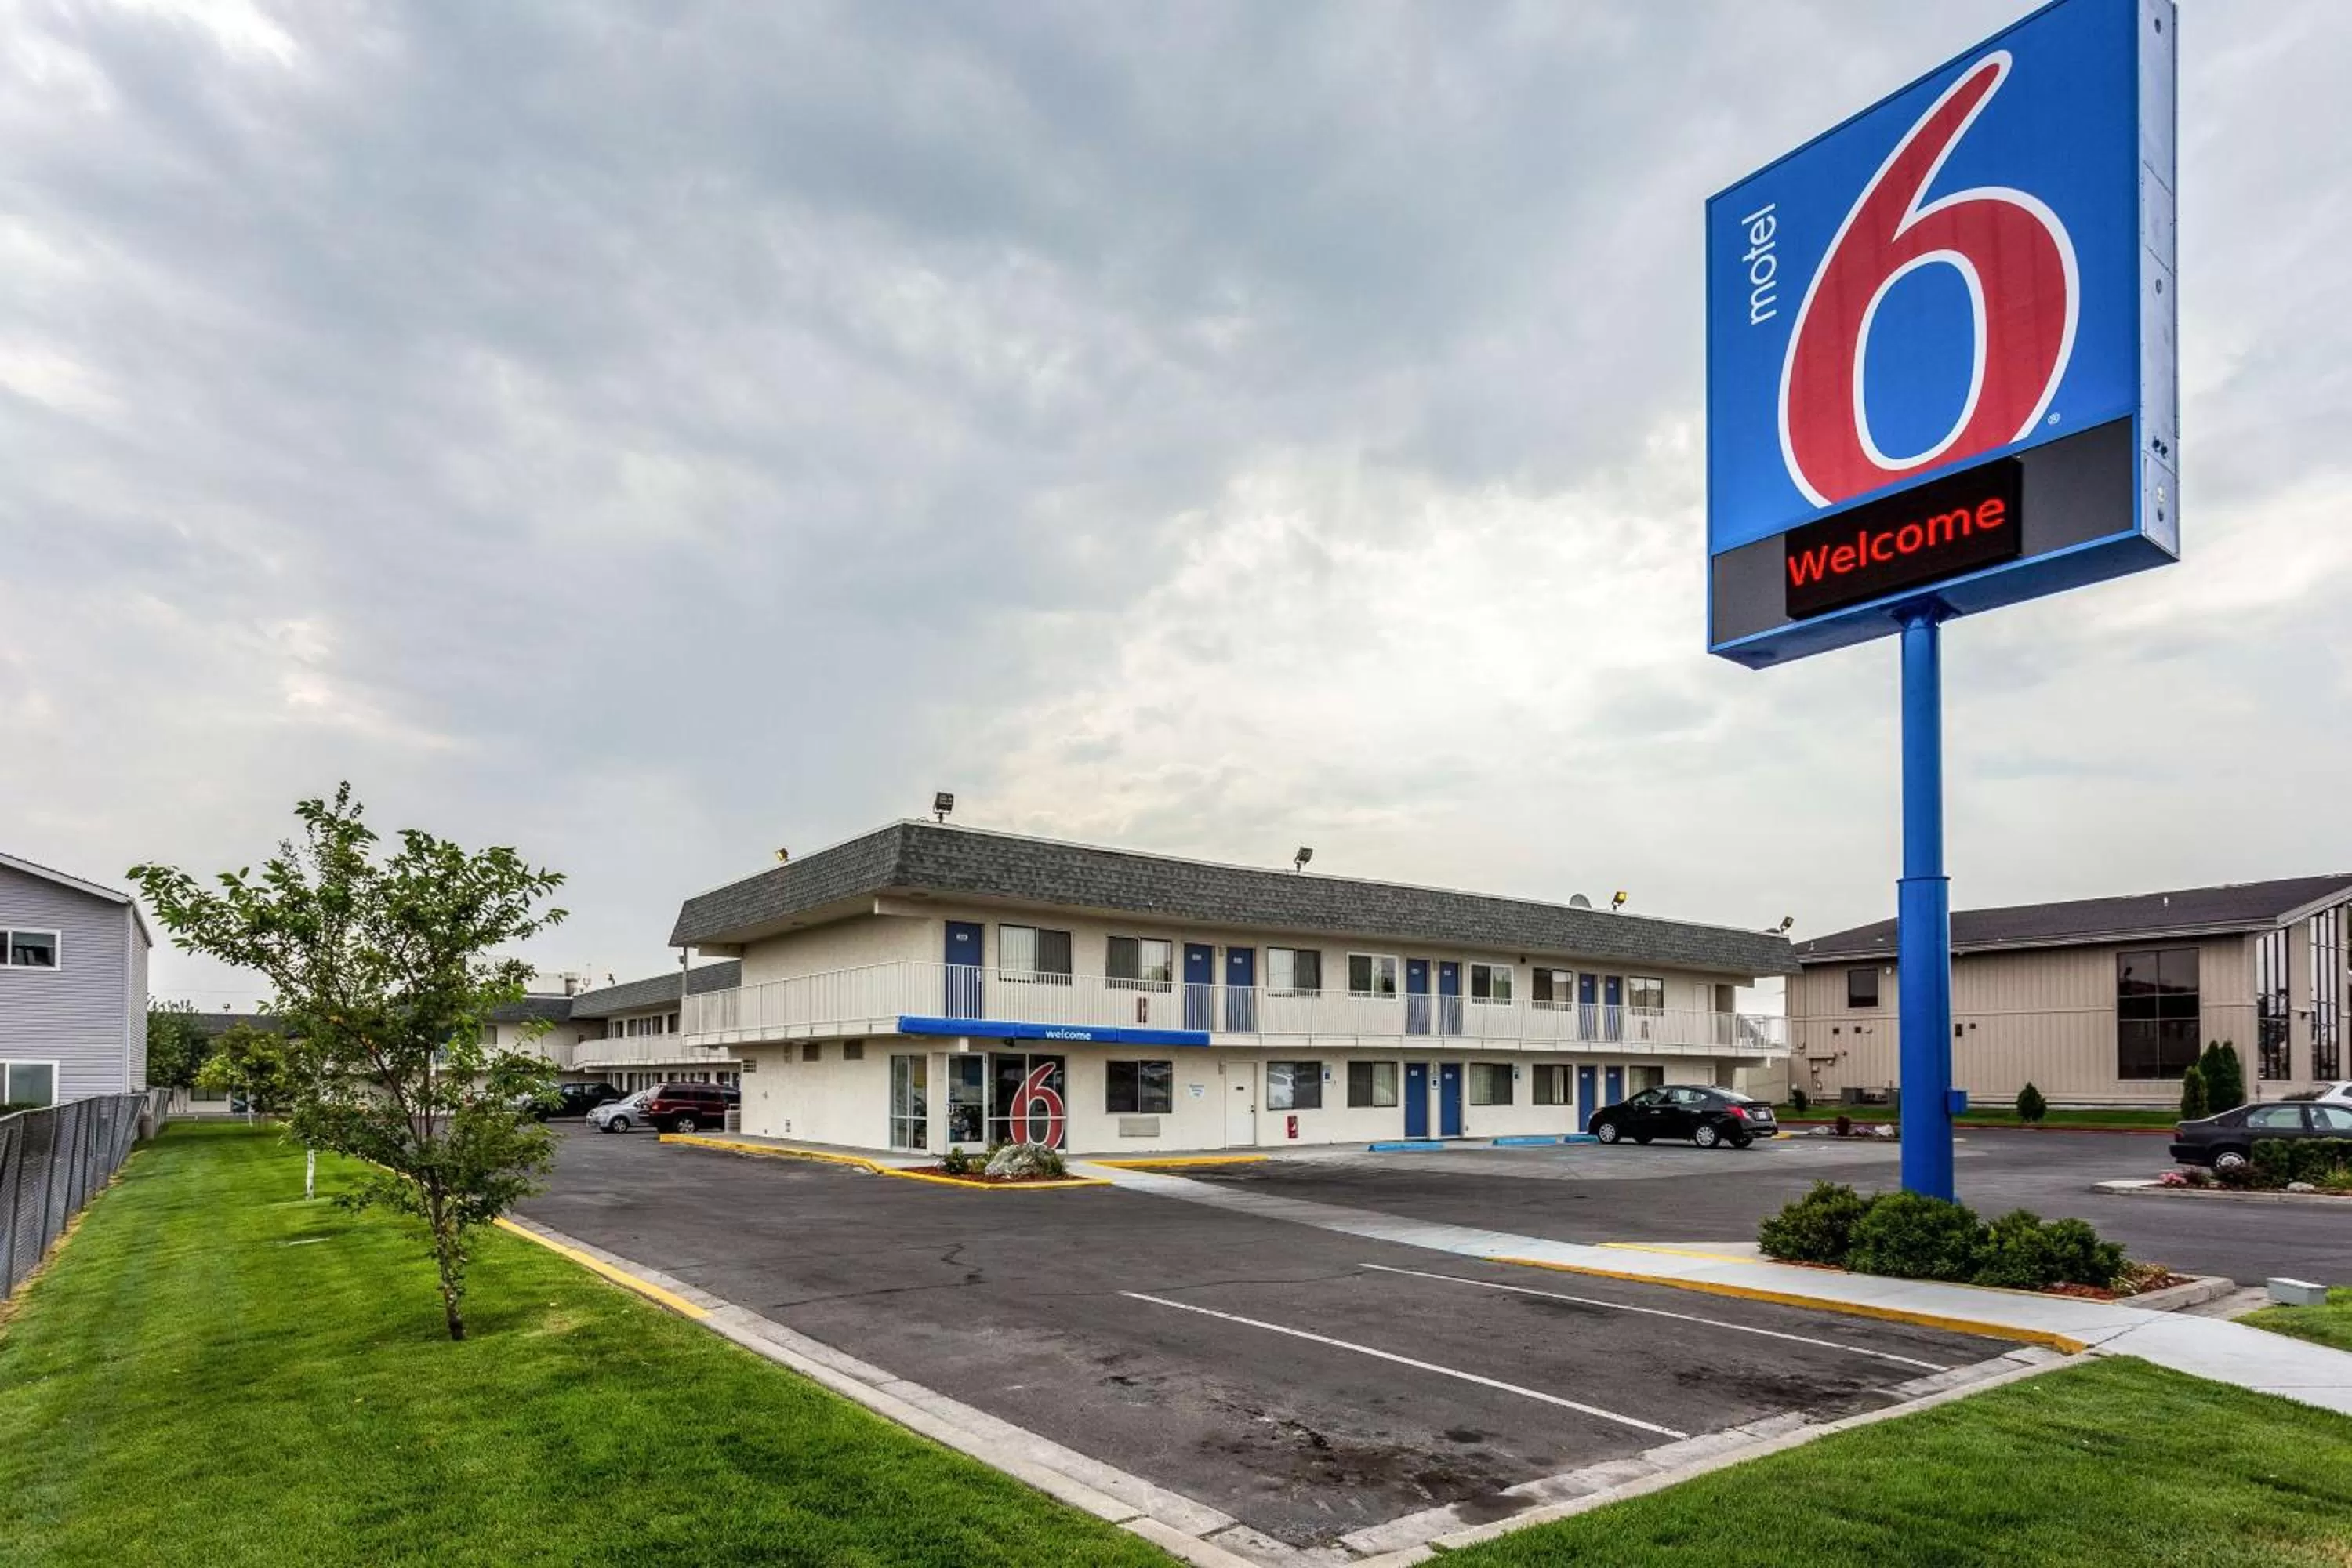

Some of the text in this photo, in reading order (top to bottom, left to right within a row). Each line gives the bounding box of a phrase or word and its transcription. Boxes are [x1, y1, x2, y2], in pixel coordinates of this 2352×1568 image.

[1741, 49, 2080, 509] motel 6
[1788, 498, 2005, 586] Welcome
[1045, 1028, 1092, 1040] welcome
[1009, 1061, 1065, 1150] 6
